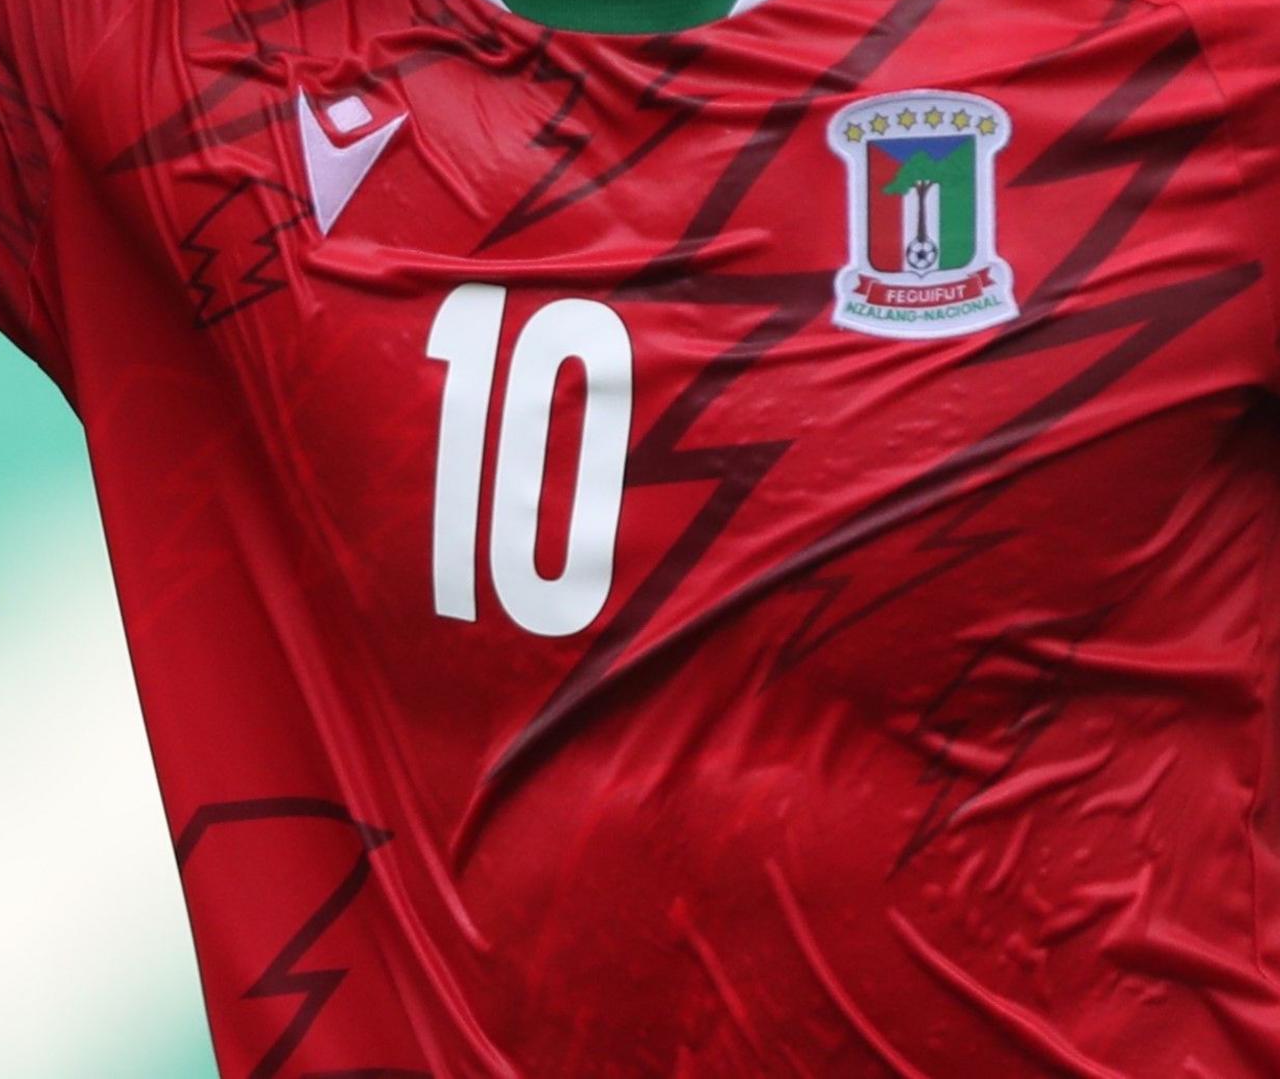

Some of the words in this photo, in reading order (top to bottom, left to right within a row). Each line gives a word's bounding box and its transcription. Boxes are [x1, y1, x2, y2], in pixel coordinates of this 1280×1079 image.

[886, 286, 966, 303] FEGUIFUT
[846, 295, 1001, 322] NZALANG-NACIONAL
[426, 282, 632, 637] 10
